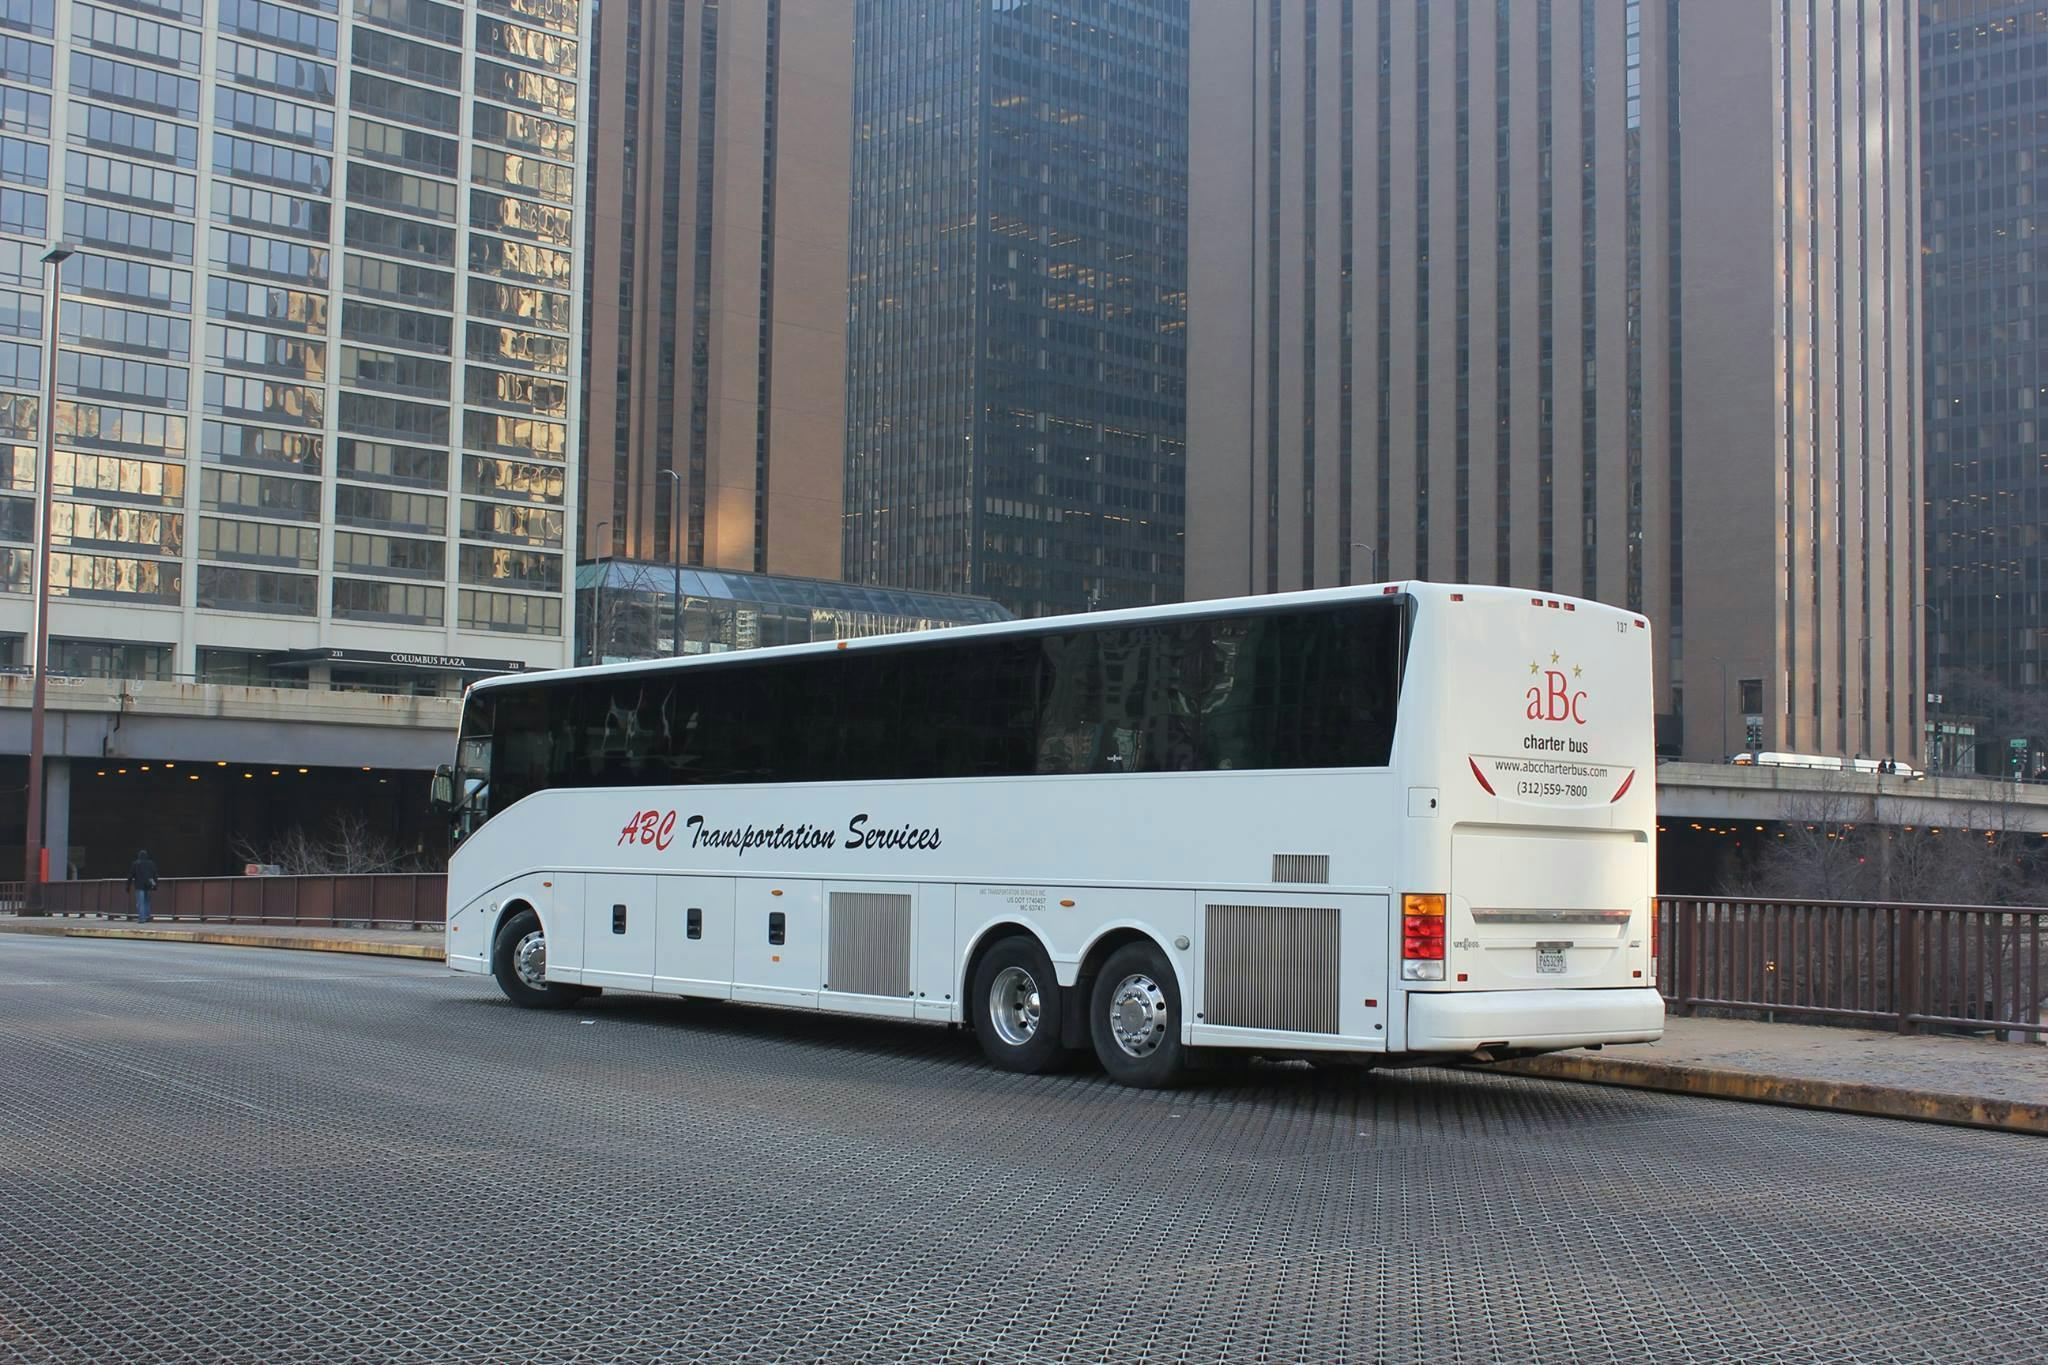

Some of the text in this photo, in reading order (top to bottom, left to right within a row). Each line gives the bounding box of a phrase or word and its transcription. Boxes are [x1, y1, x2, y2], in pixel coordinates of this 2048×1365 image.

[390, 653, 466, 667] COLUMBUS PLAZA
[1523, 734, 1589, 754] charter bus
[1495, 760, 1608, 778] www.abccharterbus.com
[1517, 781, 1588, 798] (312)559-7800
[617, 809, 942, 857] ABC Transportation Services
